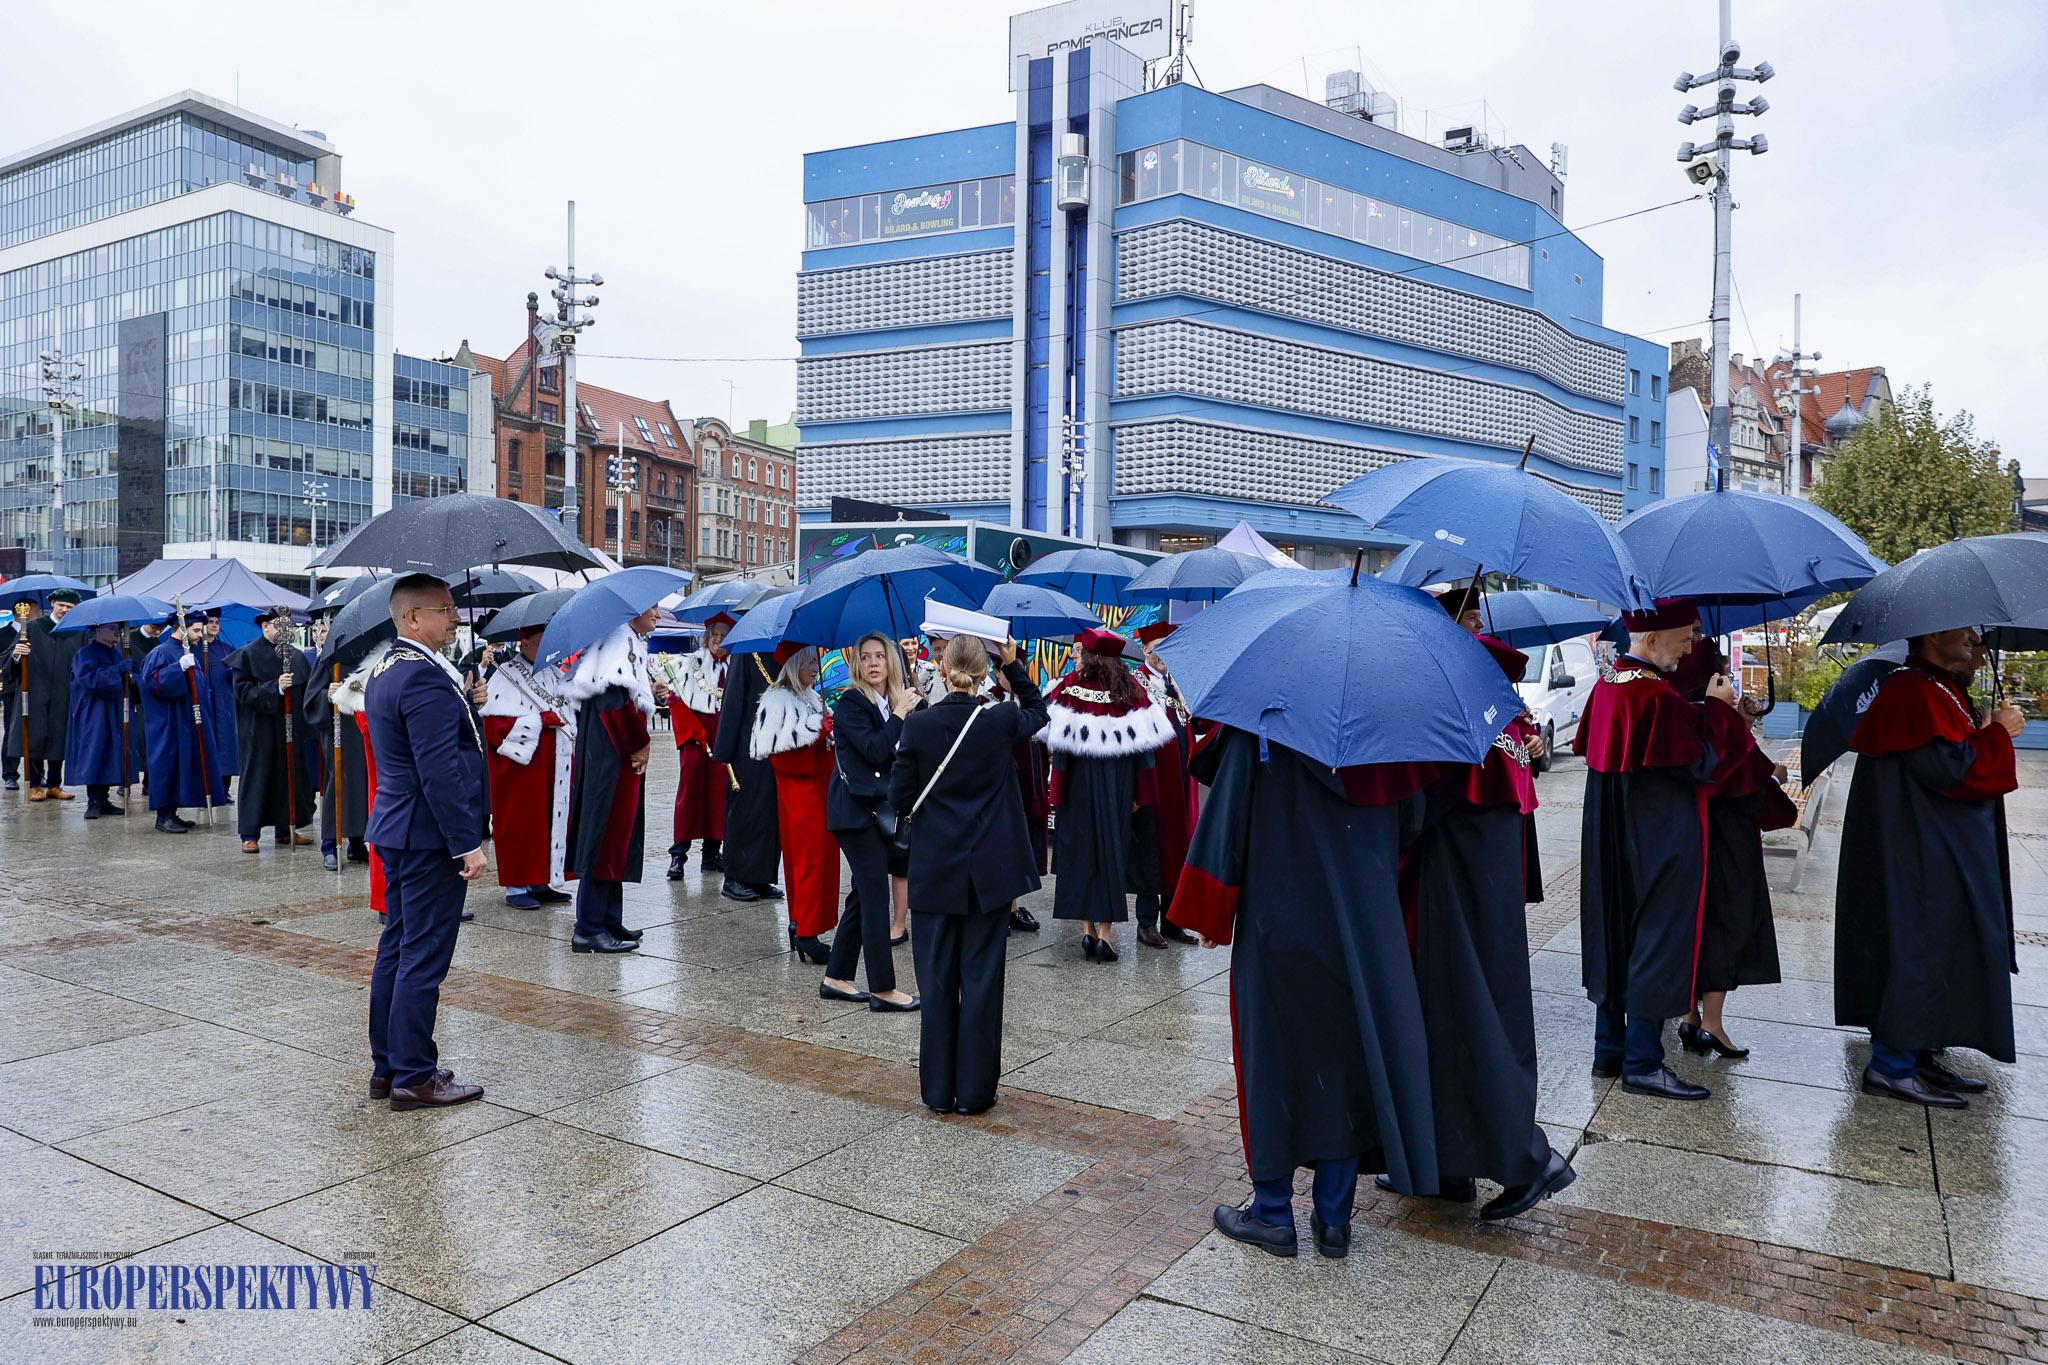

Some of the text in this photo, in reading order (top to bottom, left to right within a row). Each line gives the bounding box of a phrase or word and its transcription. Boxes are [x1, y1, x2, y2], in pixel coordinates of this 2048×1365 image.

[1085, 16, 1122, 33] KLUB
[1243, 166, 1290, 190] Bilard
[891, 190, 943, 215] Bowling
[884, 217, 954, 235] BILARD & BOWLING
[1855, 678, 1880, 714] AWF
